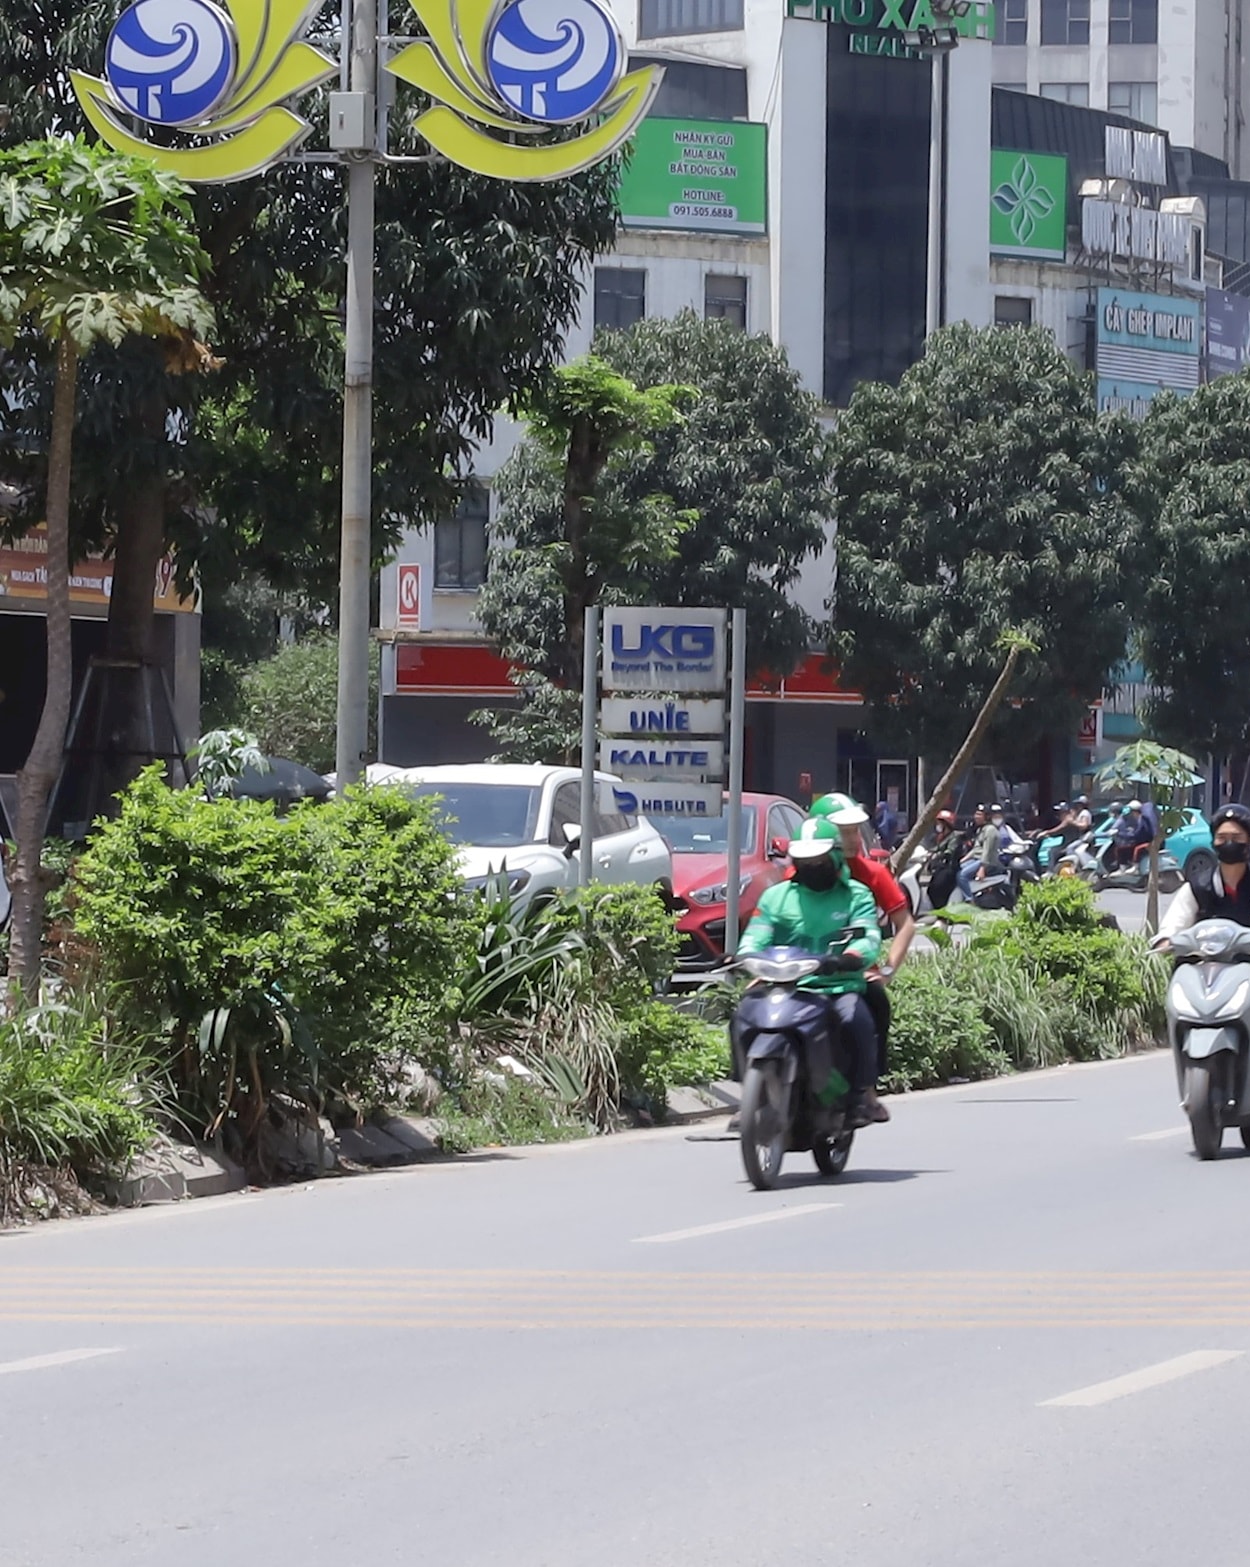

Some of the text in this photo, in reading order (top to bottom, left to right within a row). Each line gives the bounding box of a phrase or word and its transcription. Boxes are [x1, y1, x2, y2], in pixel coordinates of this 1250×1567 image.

[849, 33, 930, 59] REAL
[673, 205, 733, 218] 091.505.6888
[1154, 311, 1194, 341] IMPLANT
[612, 624, 715, 659] UKG
[611, 662, 713, 673] Beyond The Border
[610, 749, 708, 766] KALITE
